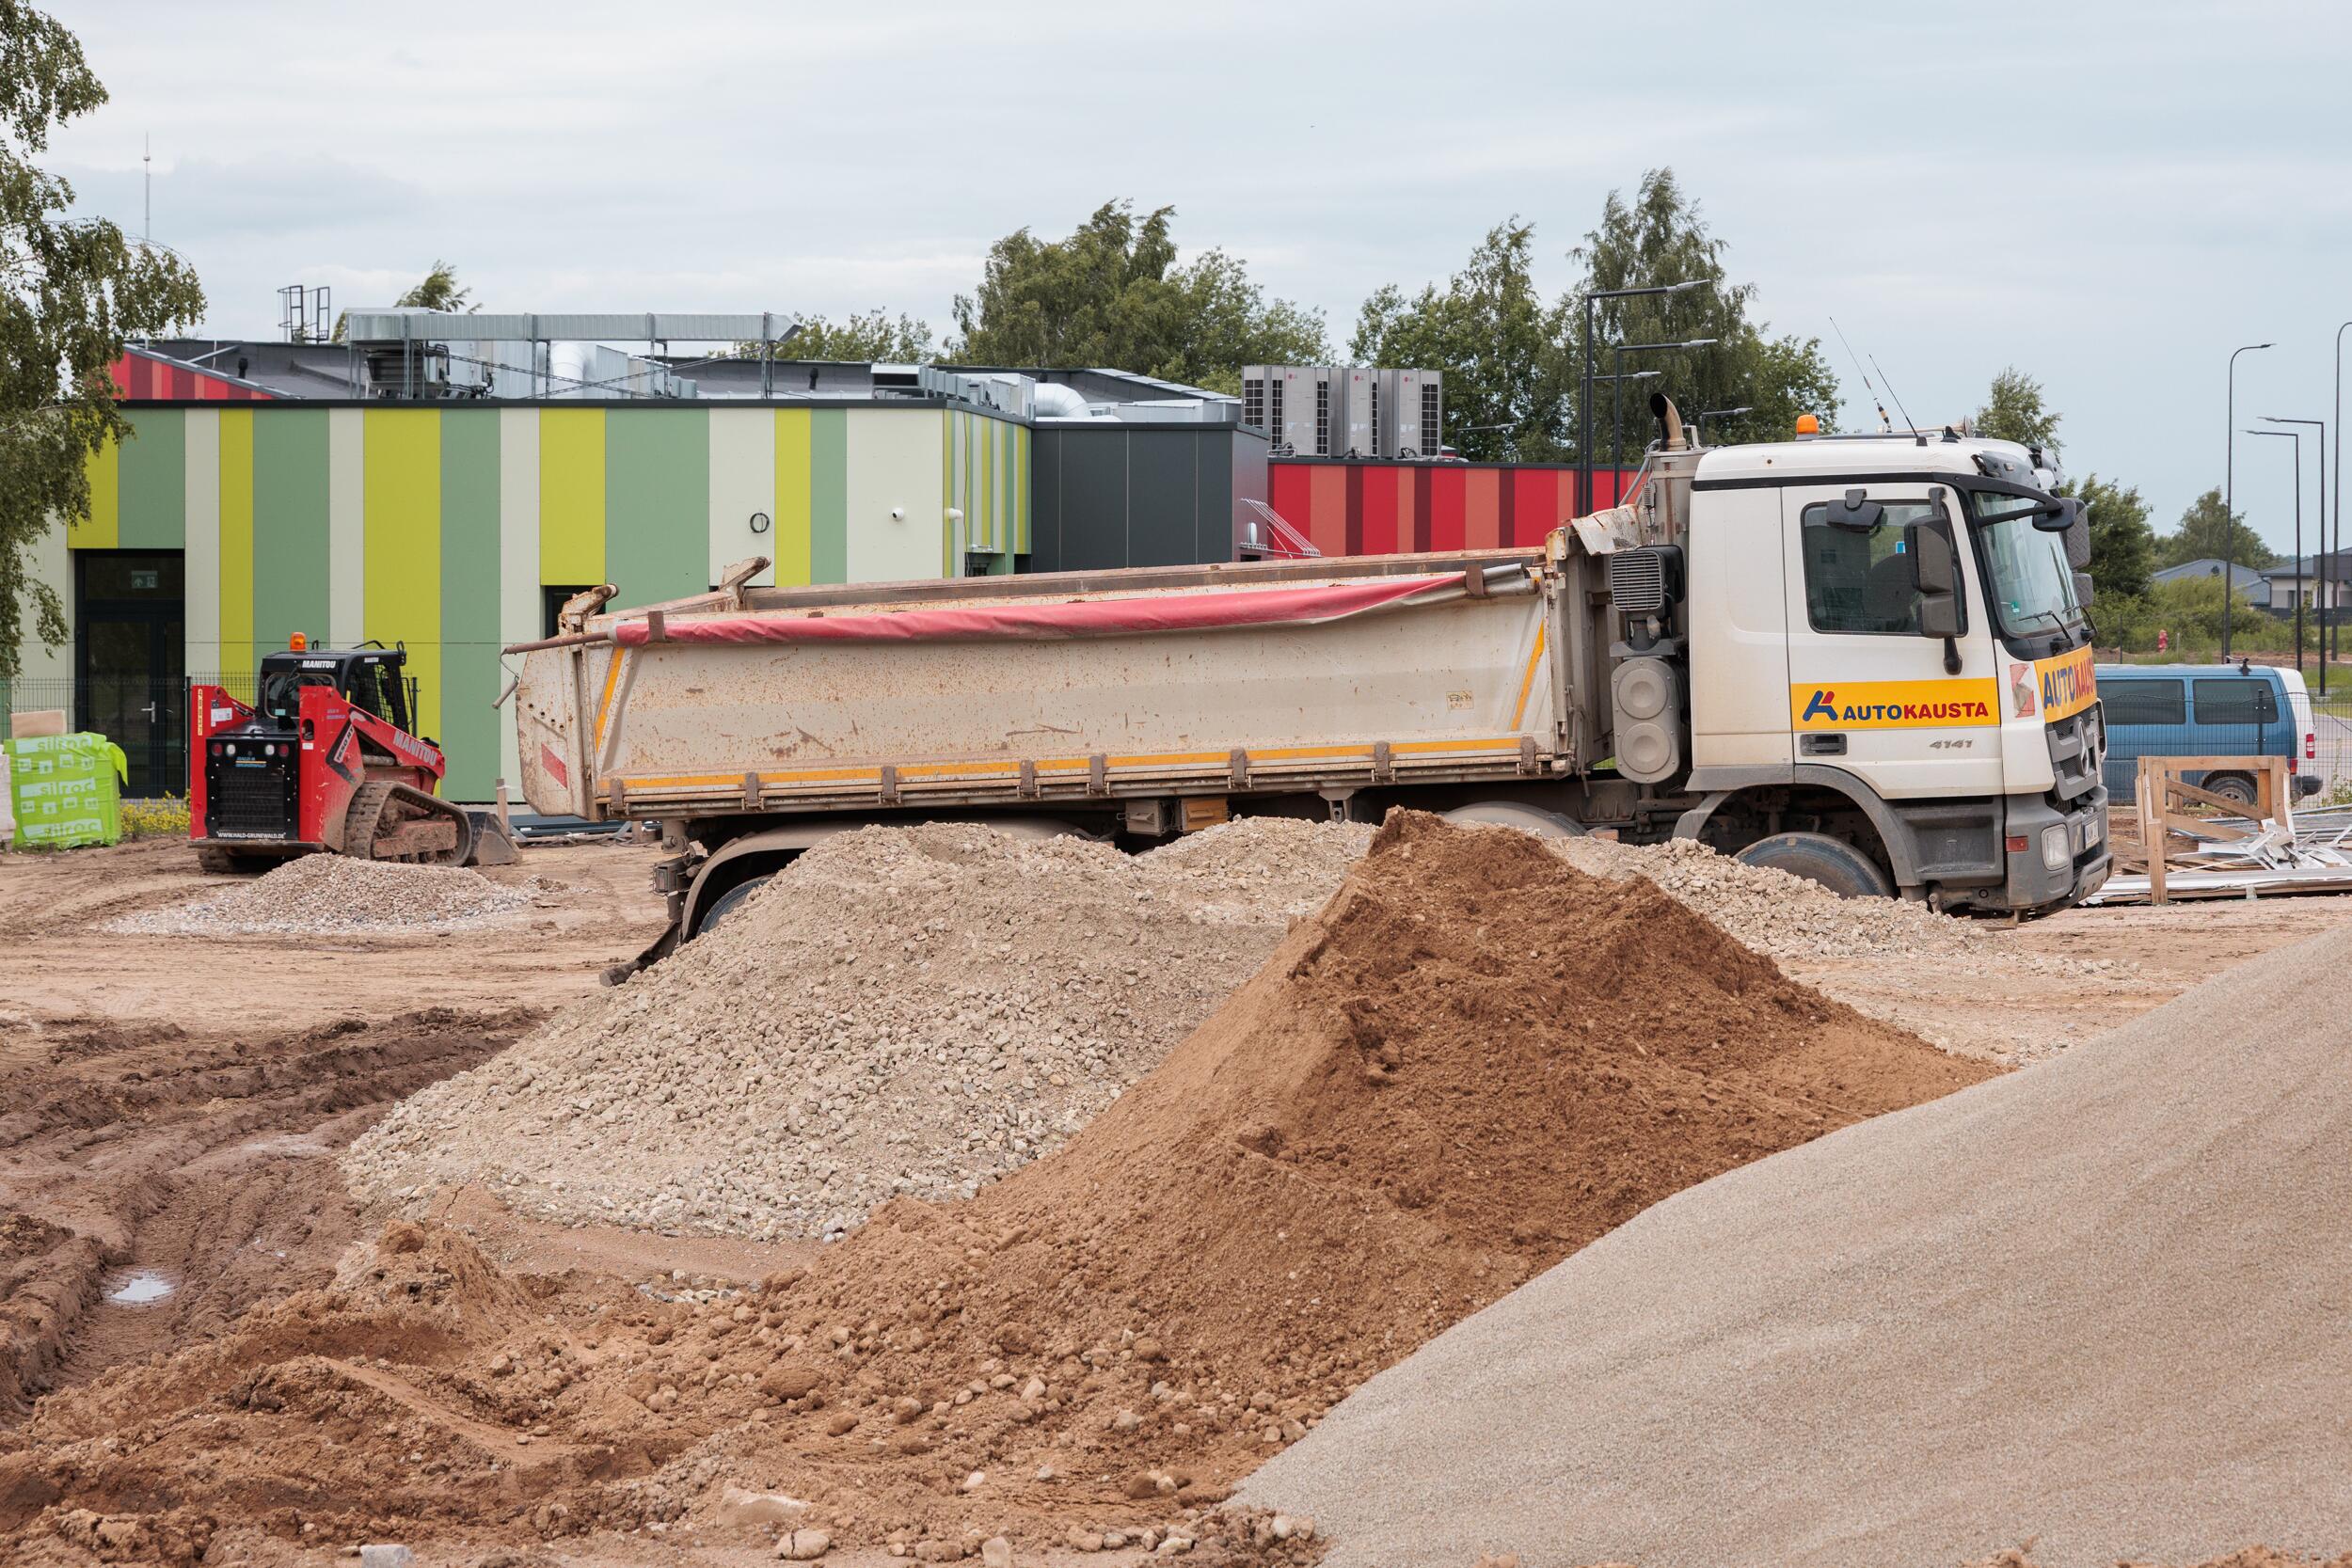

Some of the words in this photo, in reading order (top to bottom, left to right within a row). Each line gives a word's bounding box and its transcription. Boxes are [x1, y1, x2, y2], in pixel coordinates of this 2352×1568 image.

[302, 659, 337, 669] MANITOU
[1842, 702, 1989, 721] AUTOKAUSTA
[393, 729, 438, 767] MANITOU
[1930, 738, 1973, 750] 4141
